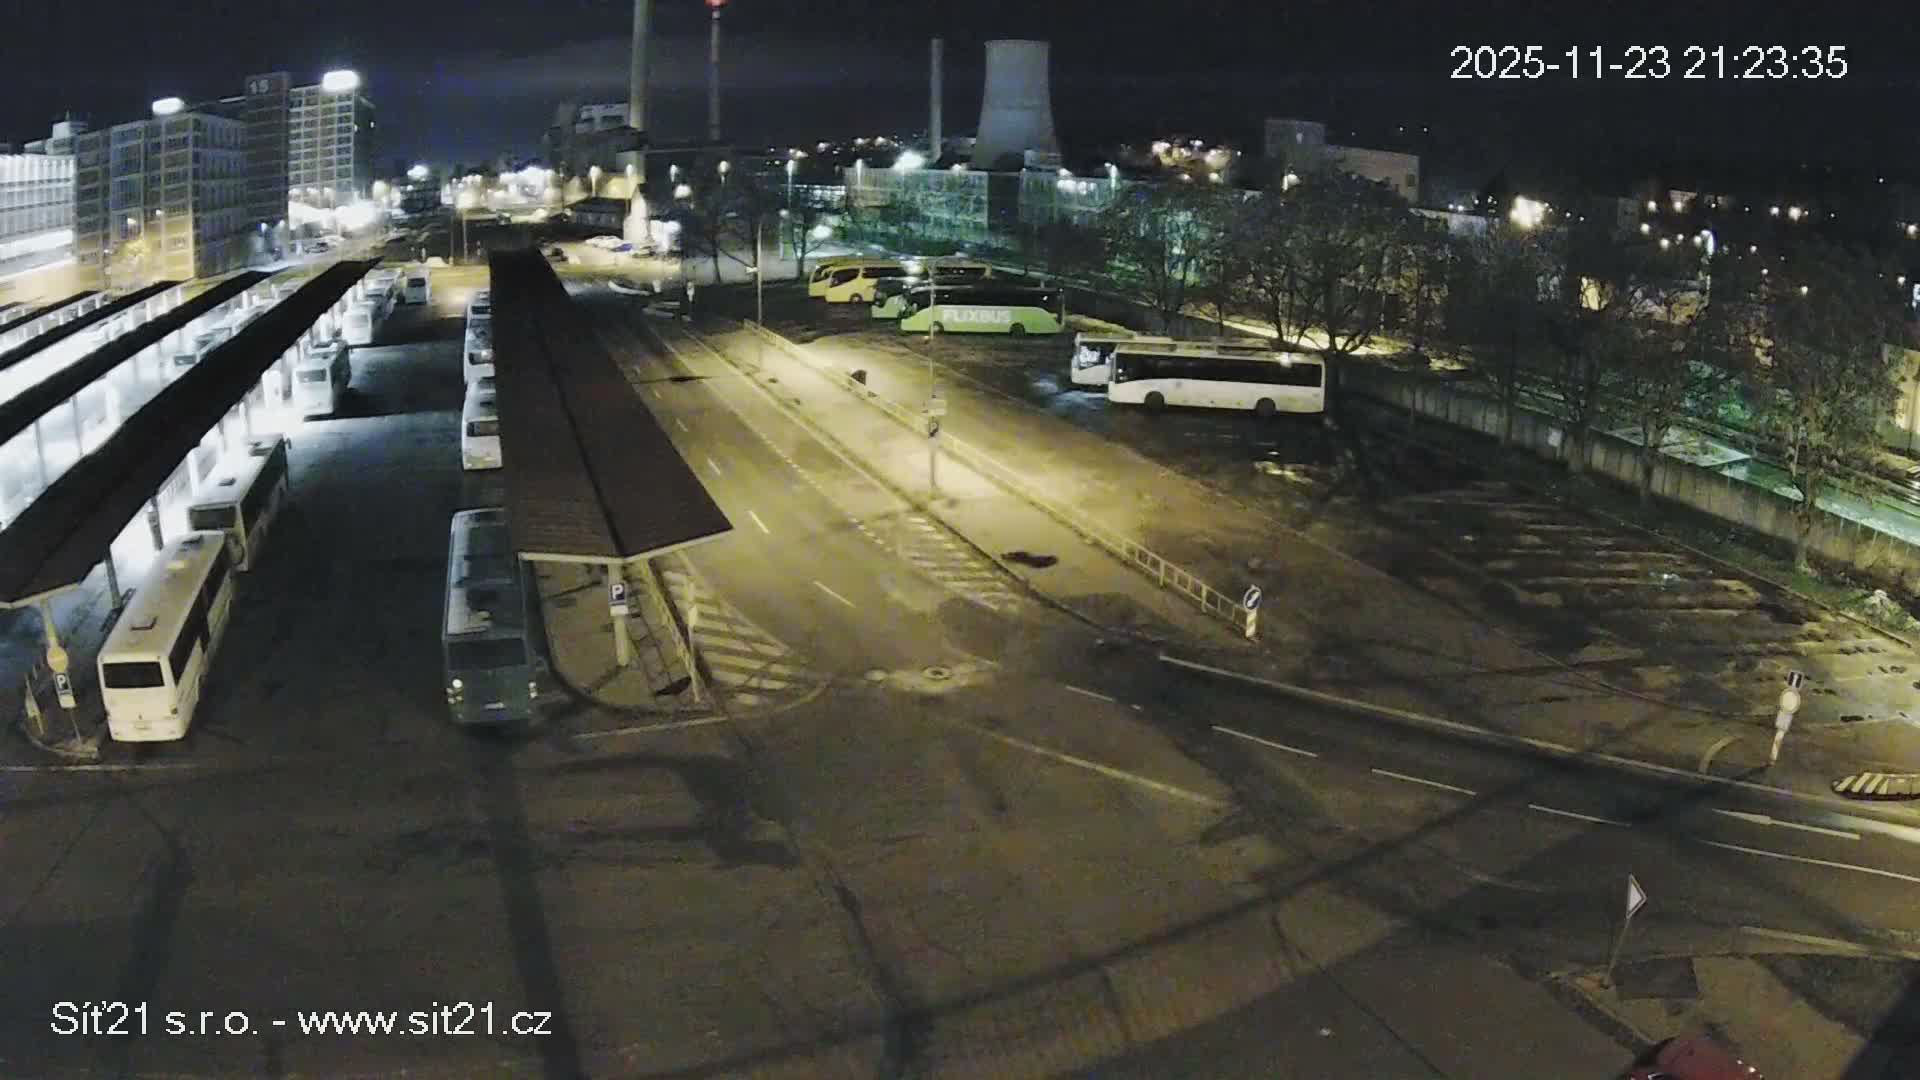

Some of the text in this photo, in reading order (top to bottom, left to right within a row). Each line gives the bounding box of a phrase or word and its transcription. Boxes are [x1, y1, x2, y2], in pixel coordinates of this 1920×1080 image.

[942, 309, 1009, 324] FLIXBUS
[612, 584, 624, 600] P
[56, 675, 66, 689] P
